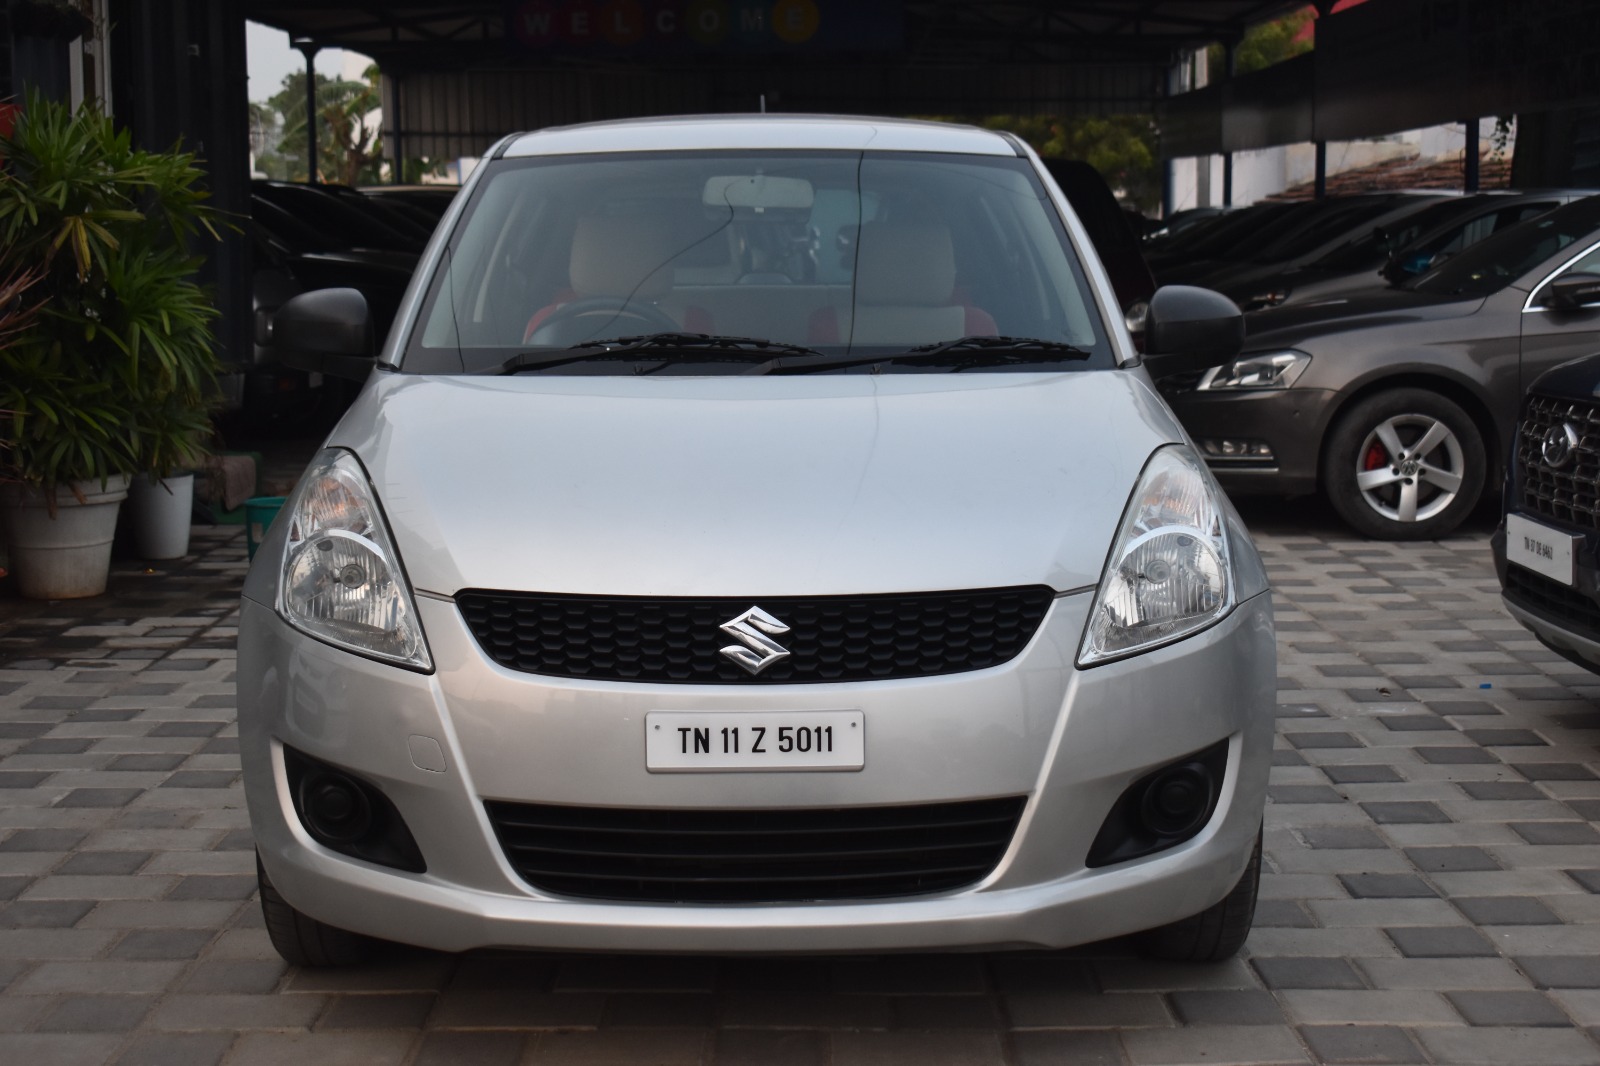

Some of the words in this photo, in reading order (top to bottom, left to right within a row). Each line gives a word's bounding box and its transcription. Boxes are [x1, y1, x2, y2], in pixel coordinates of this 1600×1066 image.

[524, 7, 805, 35] WELCOME
[677, 727, 710, 754] TN
[720, 727, 739, 754] 11
[751, 726, 767, 753] Z
[778, 725, 833, 753] 5011
